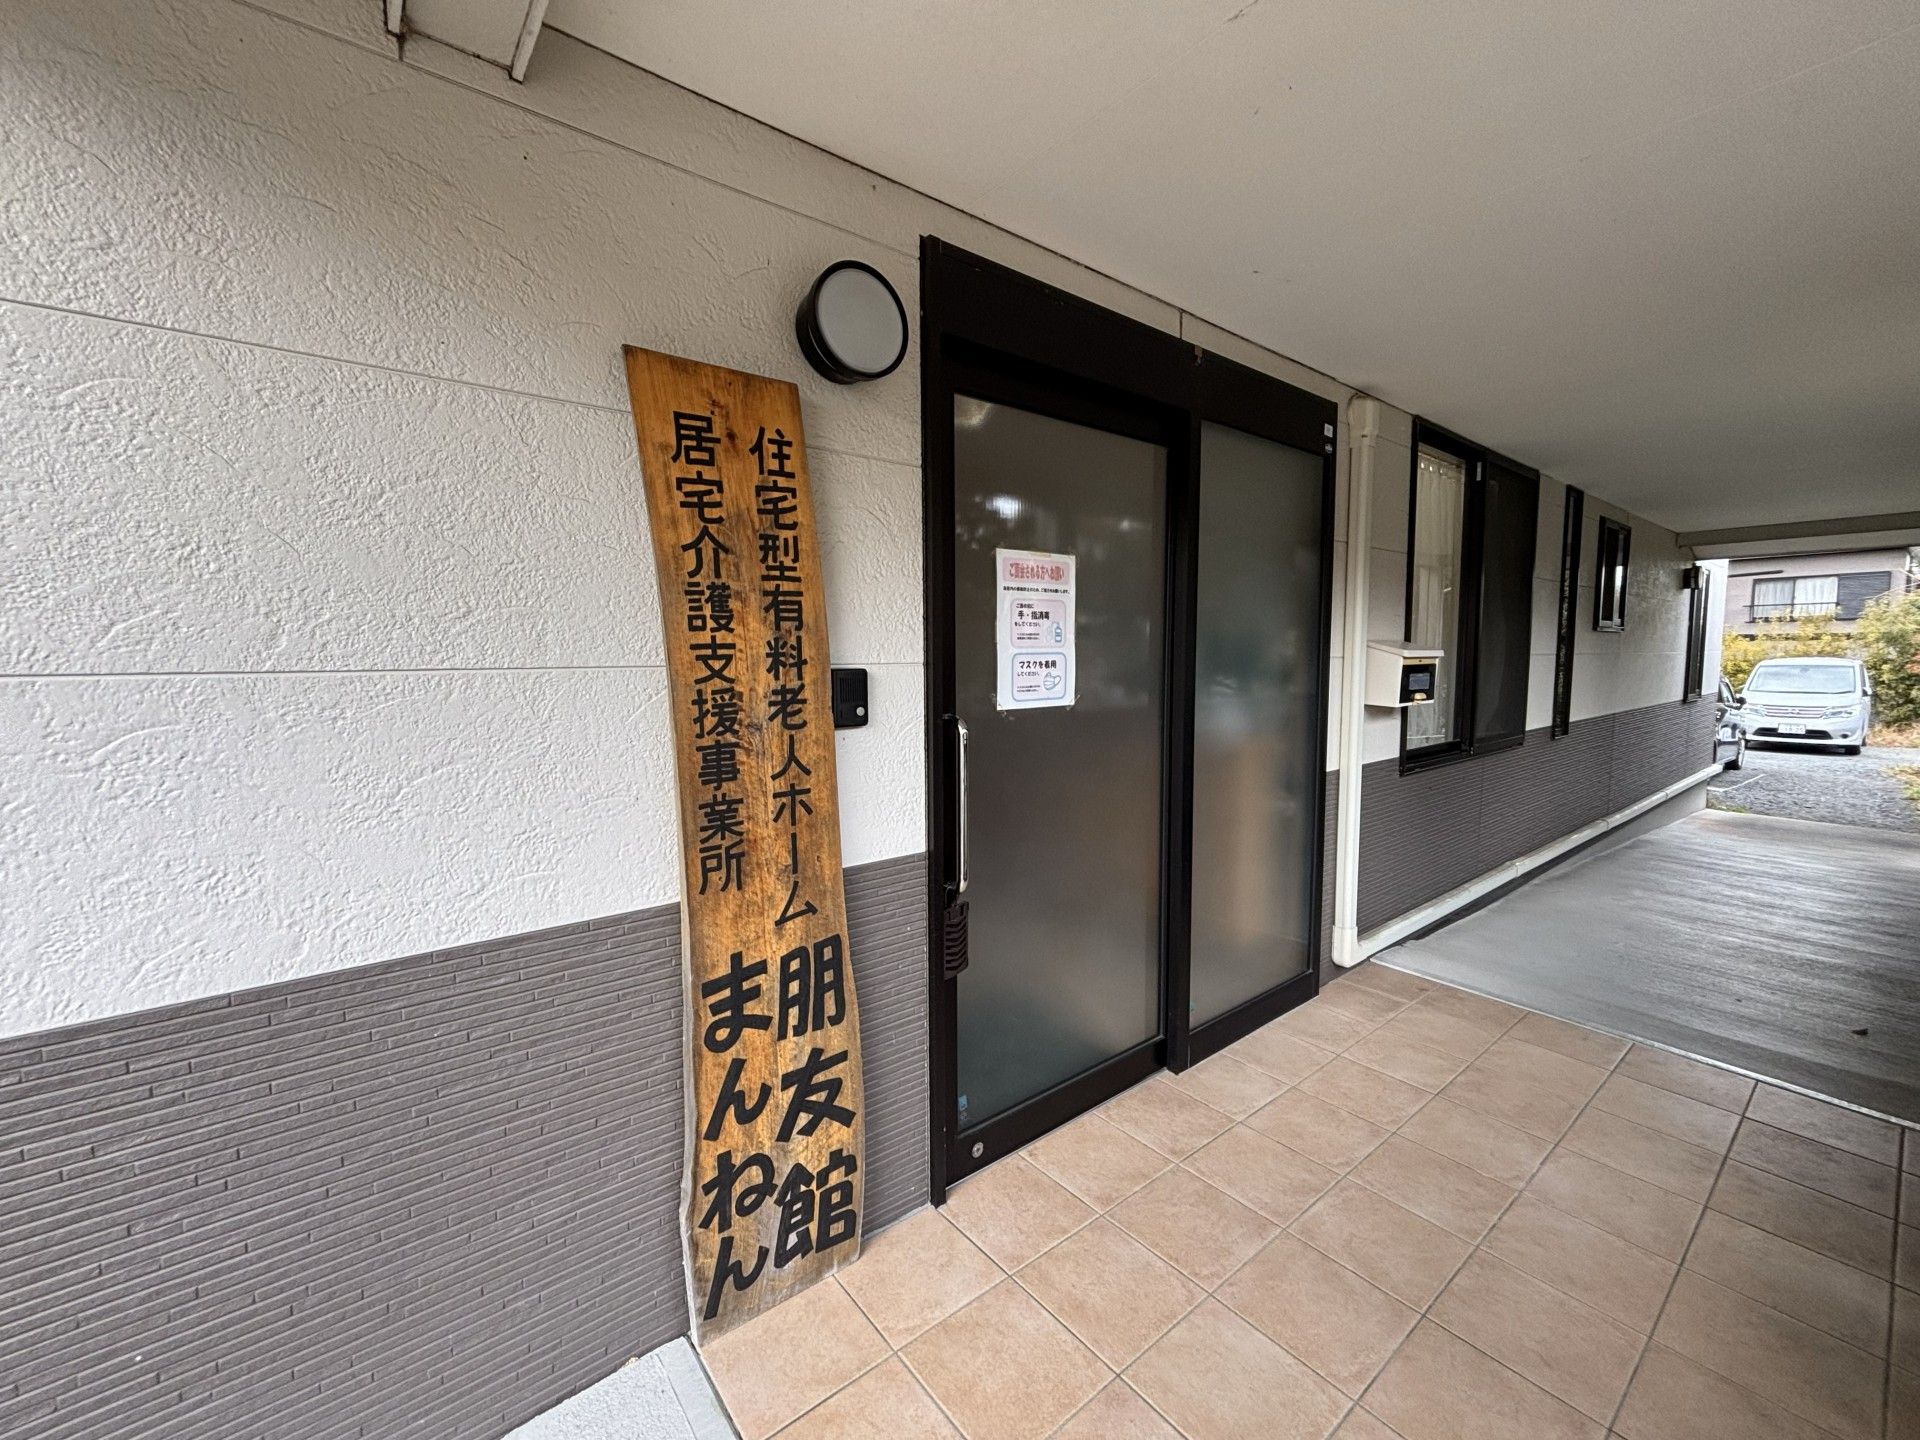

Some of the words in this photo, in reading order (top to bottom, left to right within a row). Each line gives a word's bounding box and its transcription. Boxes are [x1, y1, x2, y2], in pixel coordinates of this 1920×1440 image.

[670, 410, 746, 897] 居宅介護支援事業所
[748, 425, 820, 927] 住宅型有料老人ホーム
[1018, 659, 1057, 669] マスクを着用
[698, 950, 780, 1321] まんねん
[773, 933, 858, 1269] 朋友館
